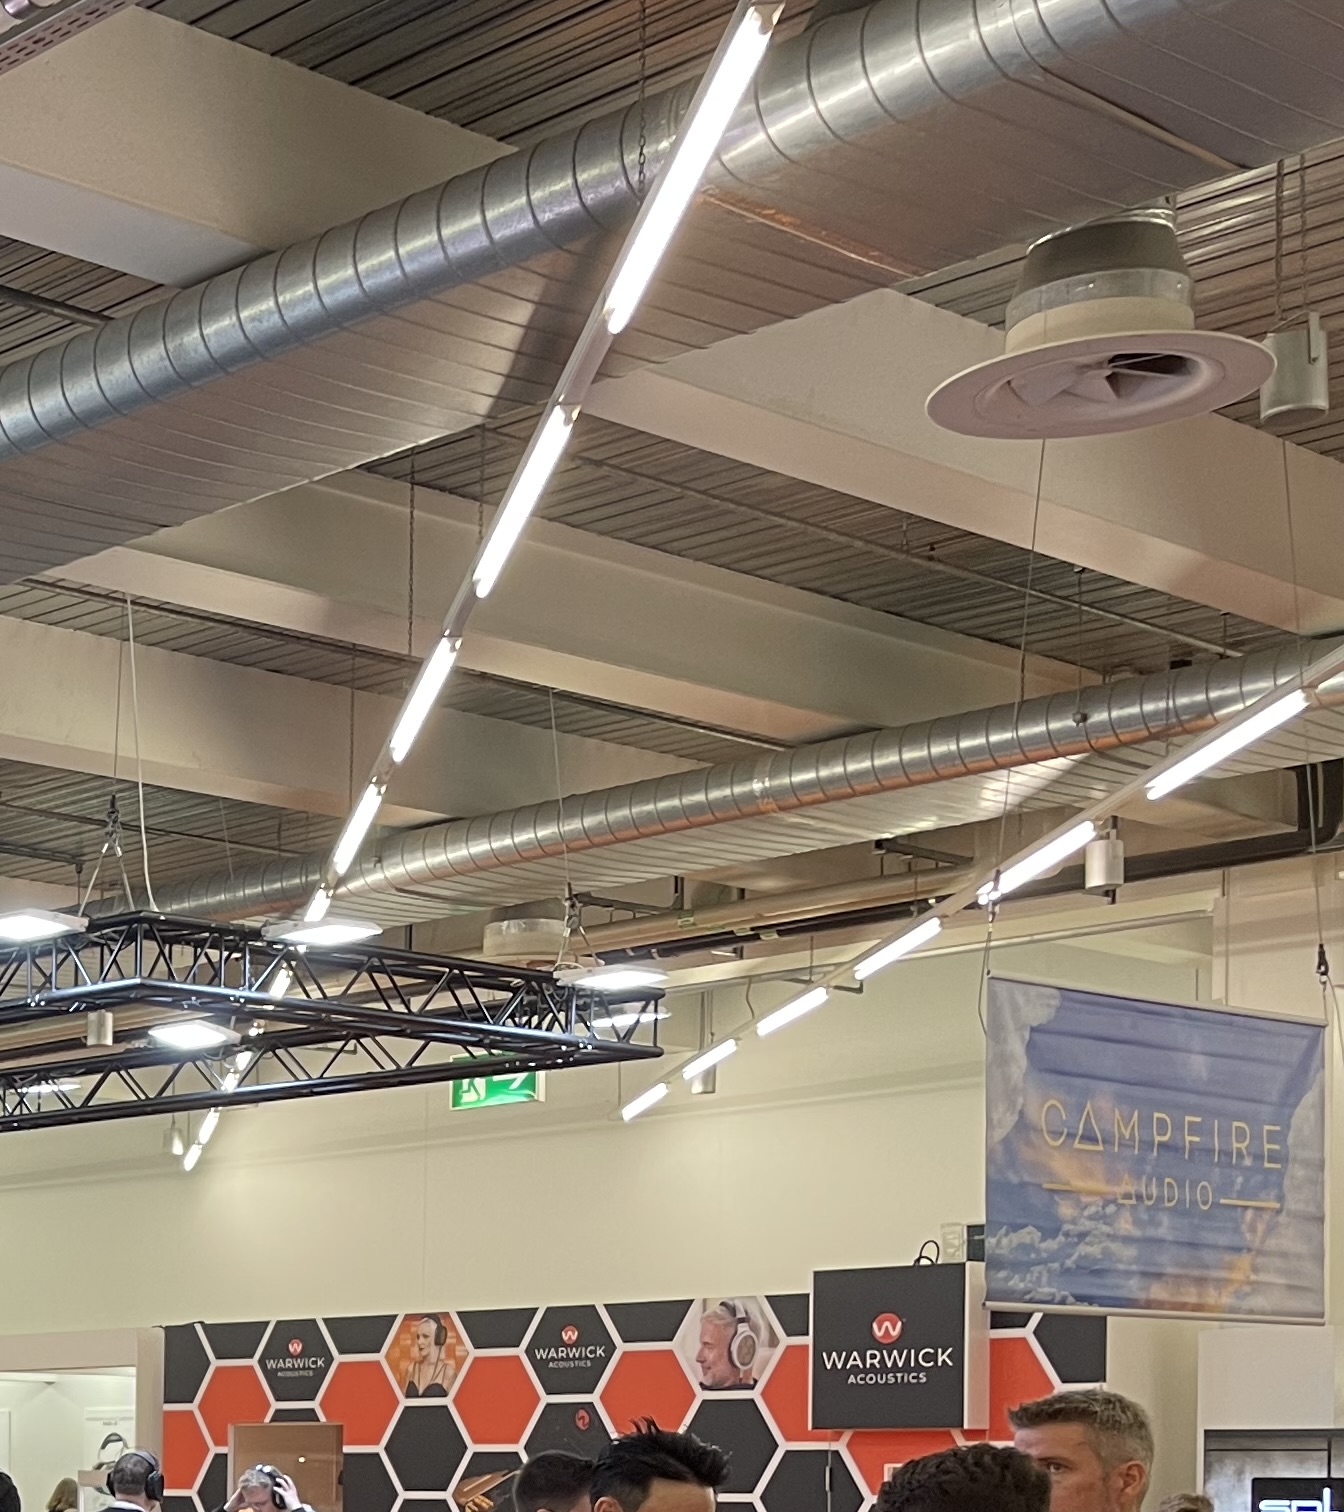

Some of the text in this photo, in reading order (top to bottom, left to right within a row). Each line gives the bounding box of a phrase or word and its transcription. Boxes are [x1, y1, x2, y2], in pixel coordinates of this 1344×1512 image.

[1041, 1098, 1282, 1169] CAMPFIRE
[1118, 1173, 1213, 1211] AUDIO
[534, 1345, 606, 1360] WARWICK
[822, 1347, 954, 1370] WARWICK
[265, 1357, 326, 1370] WARWICK
[548, 1360, 591, 1368] ACOUSTICS
[847, 1372, 928, 1385] ACOUSTICS
